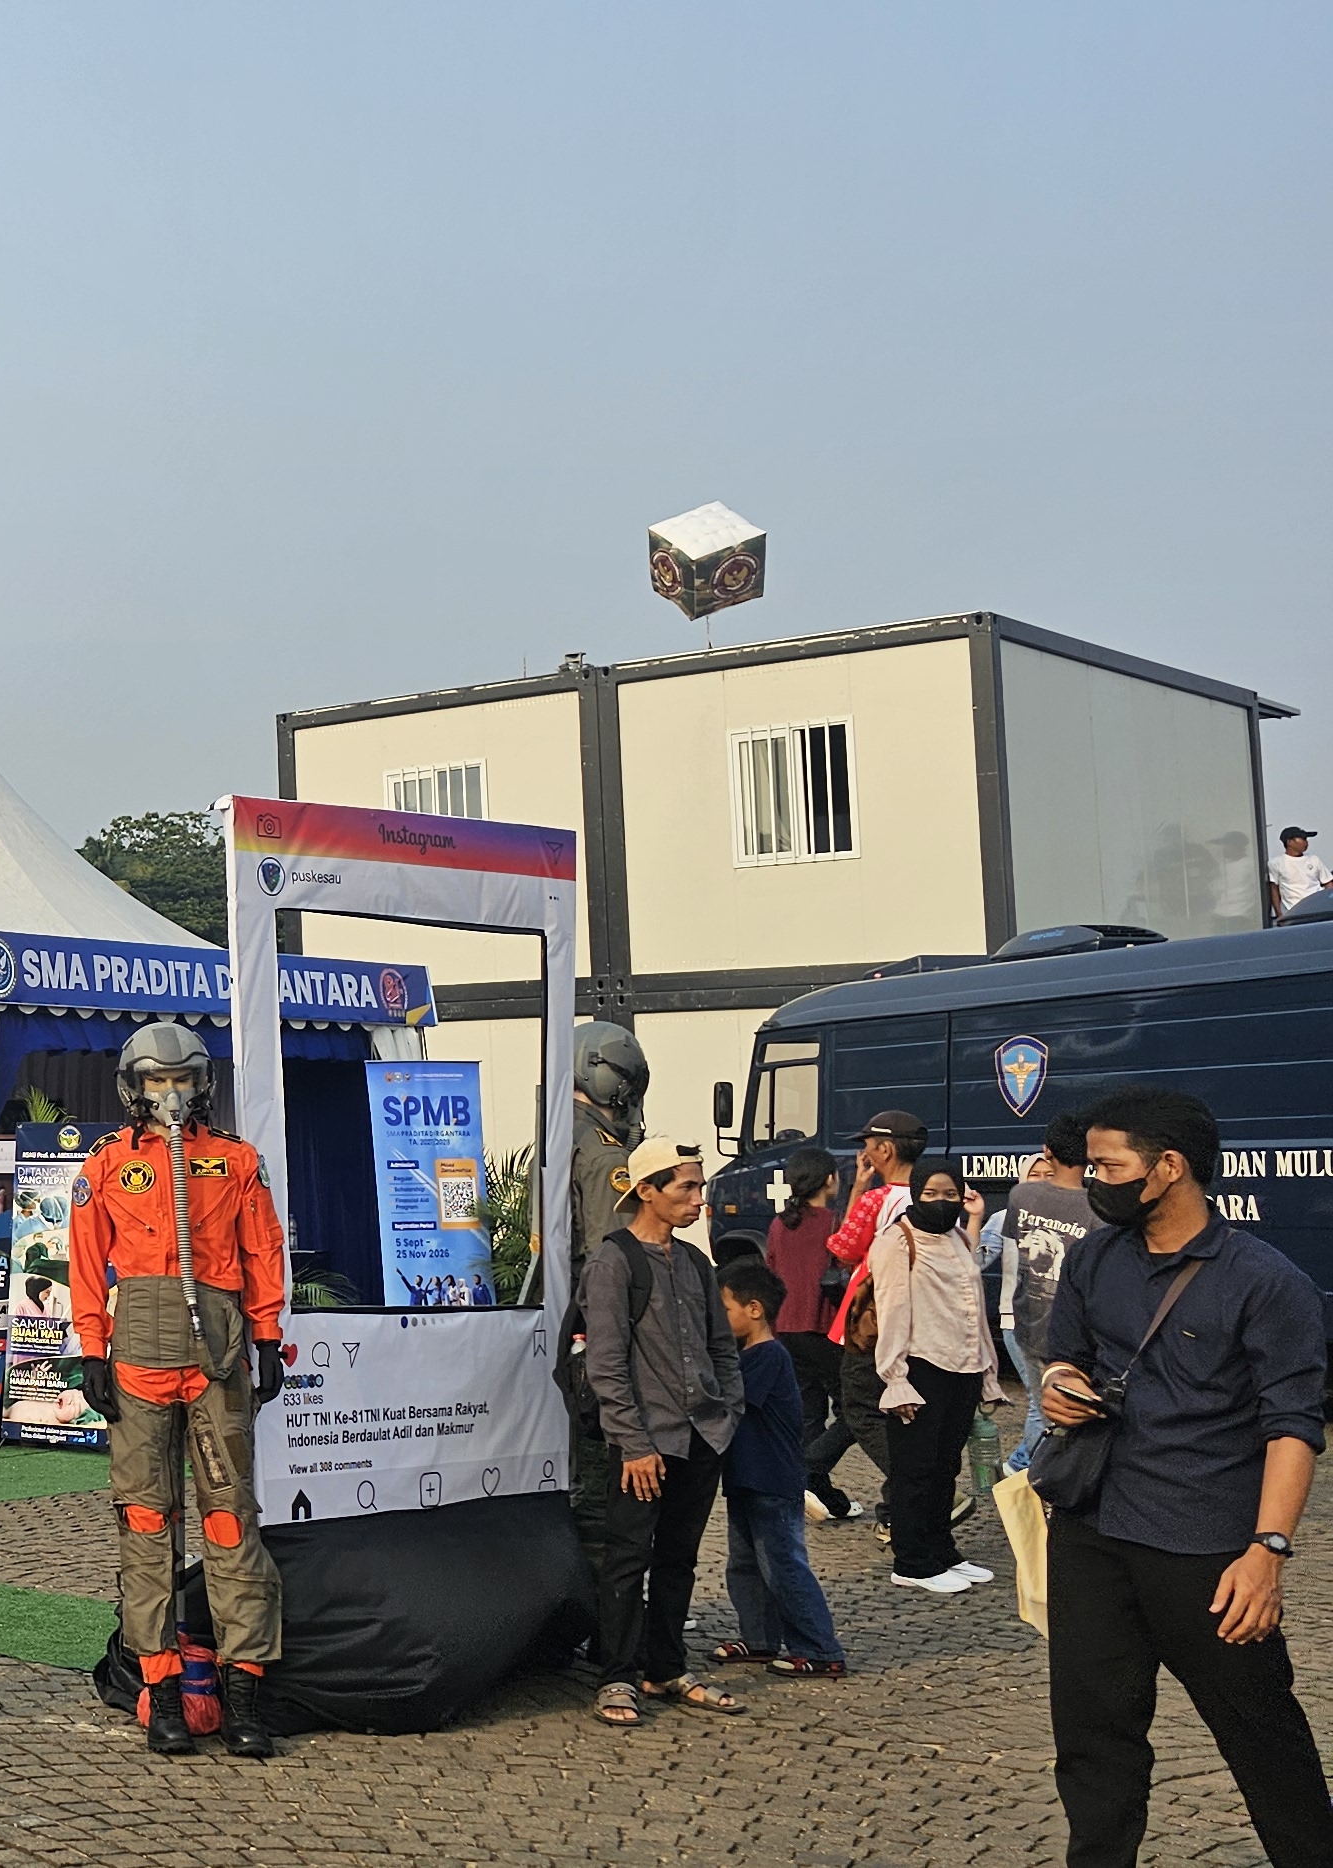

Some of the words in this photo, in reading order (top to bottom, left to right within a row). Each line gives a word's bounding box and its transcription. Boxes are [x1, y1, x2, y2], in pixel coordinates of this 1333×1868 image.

[378, 823, 456, 855] Instagram
[291, 870, 342, 885] puskesau
[22, 949, 90, 991] SMA
[93, 955, 213, 998] PRADITA
[215, 964, 379, 1009] DANTARA
[383, 1095, 471, 1126] SPMB
[18, 1167, 28, 1176] DI
[29, 1167, 70, 1176] TANGAN
[962, 1154, 1025, 1178] LEMBA
[1221, 1151, 1266, 1178] DAN
[18, 1176, 42, 1184] YANG
[44, 1177, 70, 1185] TEPAT
[1205, 1194, 1261, 1221] ARA
[396, 1238, 400, 1247] 5
[403, 1238, 424, 1249] Sept
[396, 1249, 407, 1259] 25
[409, 1249, 427, 1259] Nov
[428, 1249, 450, 1259] 2026
[12, 1318, 62, 1330] SAMBUT
[11, 1327, 39, 1337] BUAH
[41, 1329, 63, 1339] HATI
[10, 1377, 45, 1387] HARAPAN
[47, 1380, 67, 1388] BARU
[37, 1371, 61, 1381] BARU
[283, 1394, 301, 1406] 633
[303, 1393, 323, 1404] likes
[286, 1413, 310, 1428] HUT
[313, 1412, 331, 1426] TNI
[382, 1407, 406, 1422] Kuat
[408, 1404, 453, 1419] Bersama
[455, 1401, 490, 1417] Rakyat,
[287, 1431, 339, 1448] Indonesia
[342, 1427, 390, 1443] Berdaulat
[392, 1424, 412, 1440] Adil
[415, 1424, 434, 1438] dan
[437, 1420, 474, 1436] Makmur
[289, 1464, 307, 1474] View
[309, 1462, 318, 1473] all
[335, 1459, 373, 1471] comments
